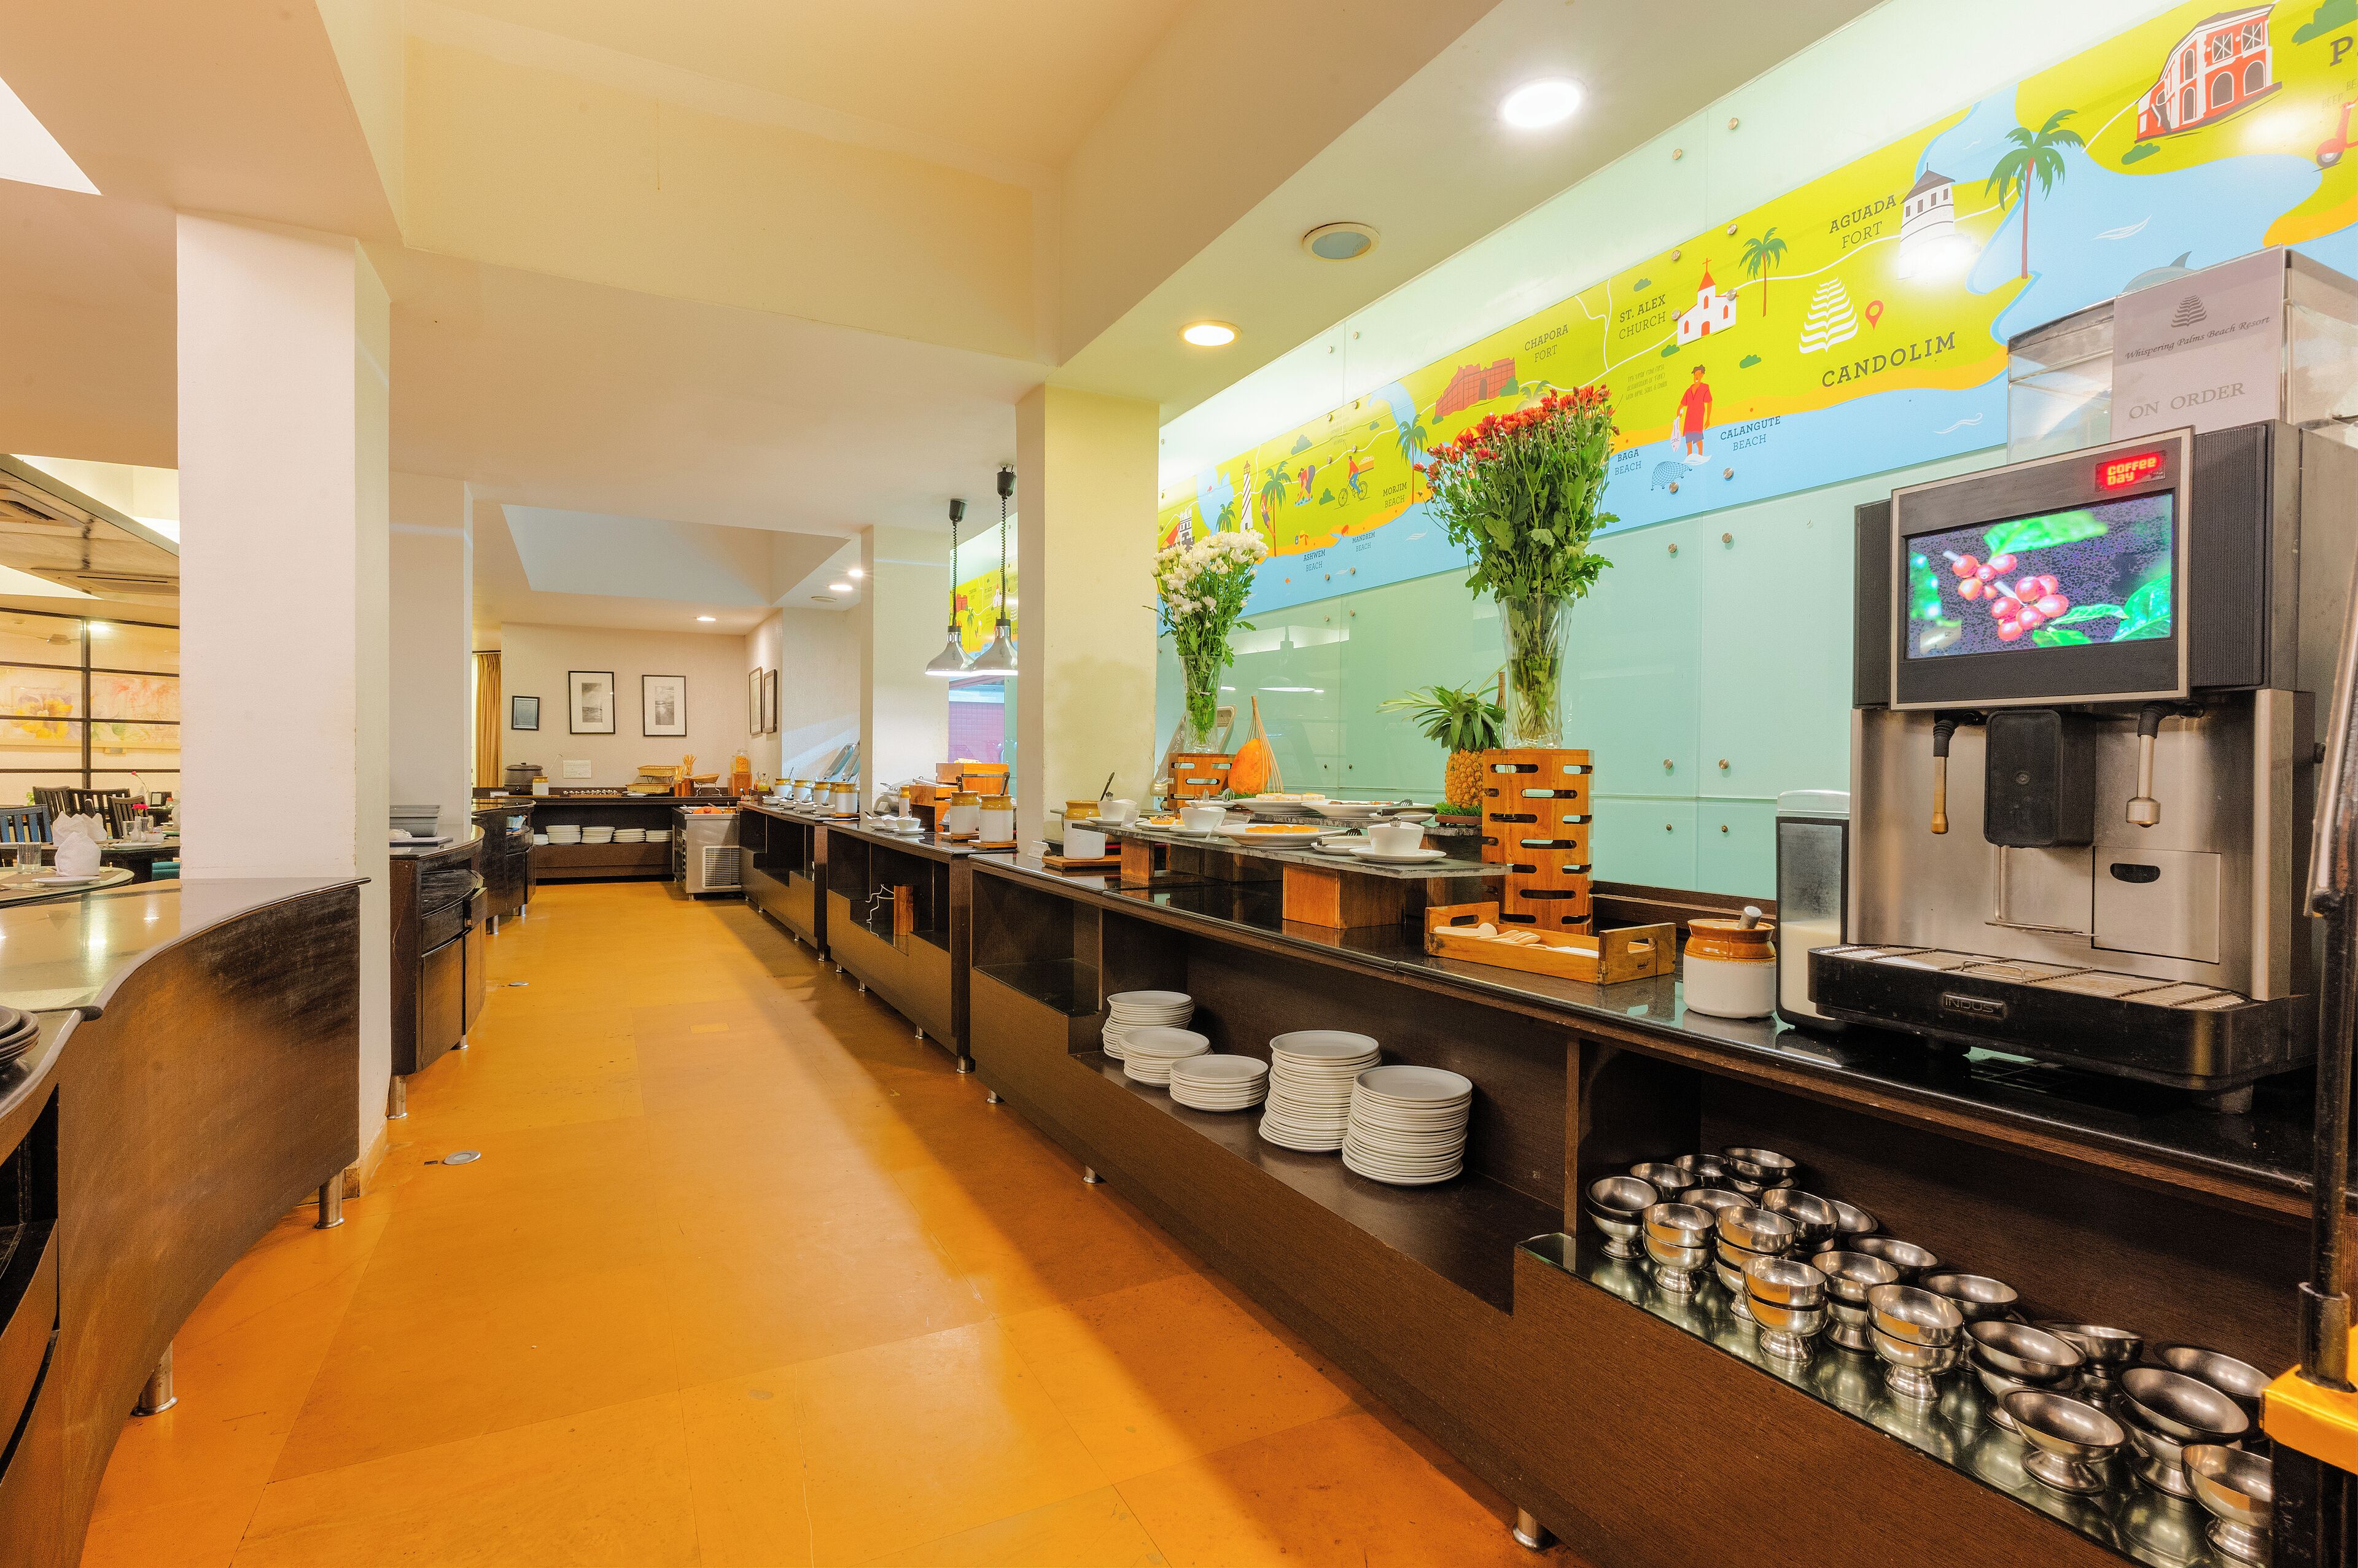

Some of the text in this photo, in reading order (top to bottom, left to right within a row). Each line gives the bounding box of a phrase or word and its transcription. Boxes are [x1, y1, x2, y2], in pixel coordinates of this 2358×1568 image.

[2329, 36, 2358, 67] P
[1829, 195, 1897, 234] AGUADA
[1842, 221, 1883, 249] FORT
[1619, 294, 1666, 322] ST. ALEX
[1619, 311, 1666, 340] CHURCH
[1524, 324, 1569, 351] CHAPORA
[2125, 316, 2270, 360] Whispering Palms Beach Resort
[1534, 344, 1558, 363] FORT
[1822, 331, 1955, 387] CANDOLIM
[2128, 382, 2246, 419] ON ORDER
[1720, 416, 1781, 440] CALANGUTE
[1733, 433, 1767, 451] BEACH
[1617, 449, 1639, 462] BAGA
[1615, 460, 1641, 475] BEACH
[1383, 481, 1407, 496] MORJIM
[1385, 495, 1405, 508] BEACH
[1352, 531, 1376, 543] MANDREM
[1303, 549, 1326, 562] ASHWEM
[1356, 542, 1371, 552] BEACH
[1305, 561, 1323, 572] BEACH
[1945, 996, 1994, 1013] INDUS
